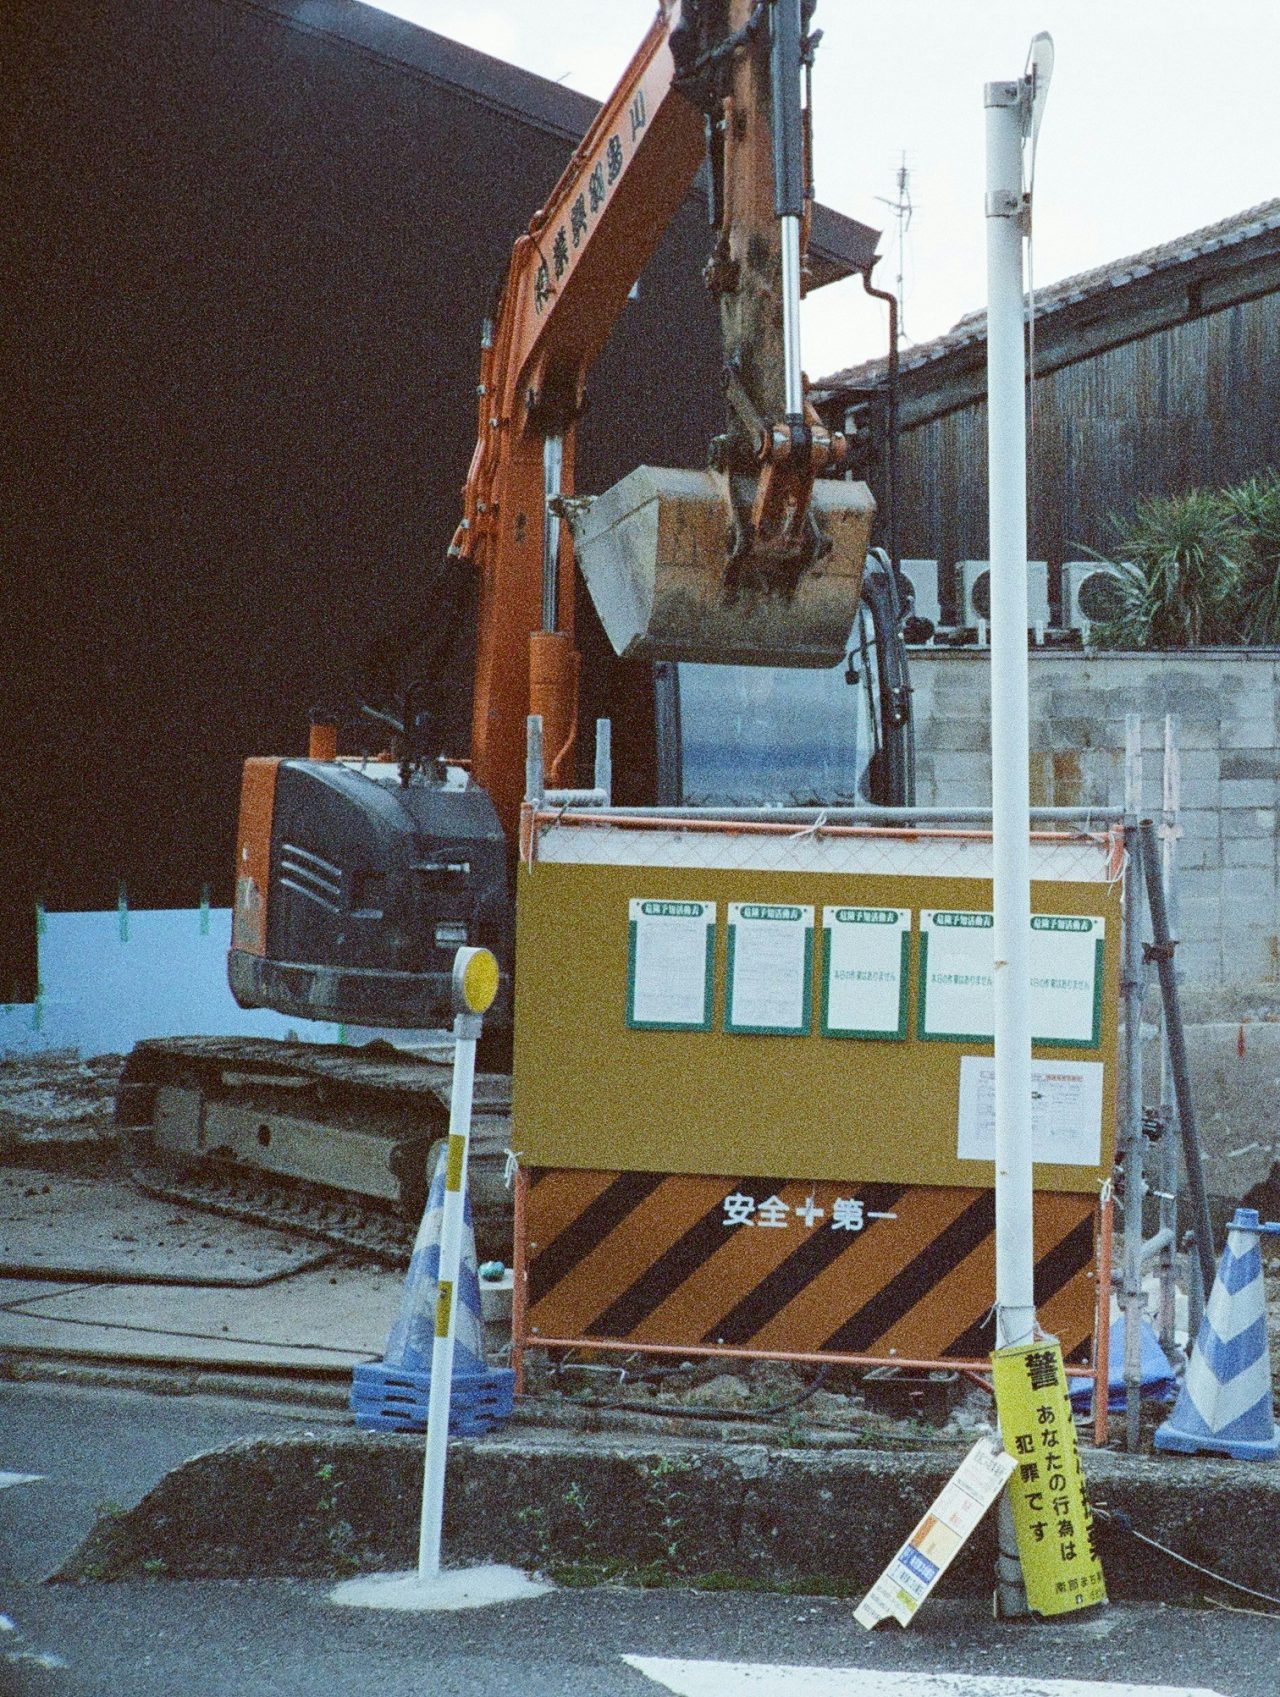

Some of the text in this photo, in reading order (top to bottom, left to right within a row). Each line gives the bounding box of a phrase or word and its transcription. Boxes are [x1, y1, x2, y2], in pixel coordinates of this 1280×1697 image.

[1024, 1350, 1060, 1391] 警
[1014, 1434, 1049, 1543] 犯罪です
[1036, 1404, 1077, 1562] あなたの行為は
